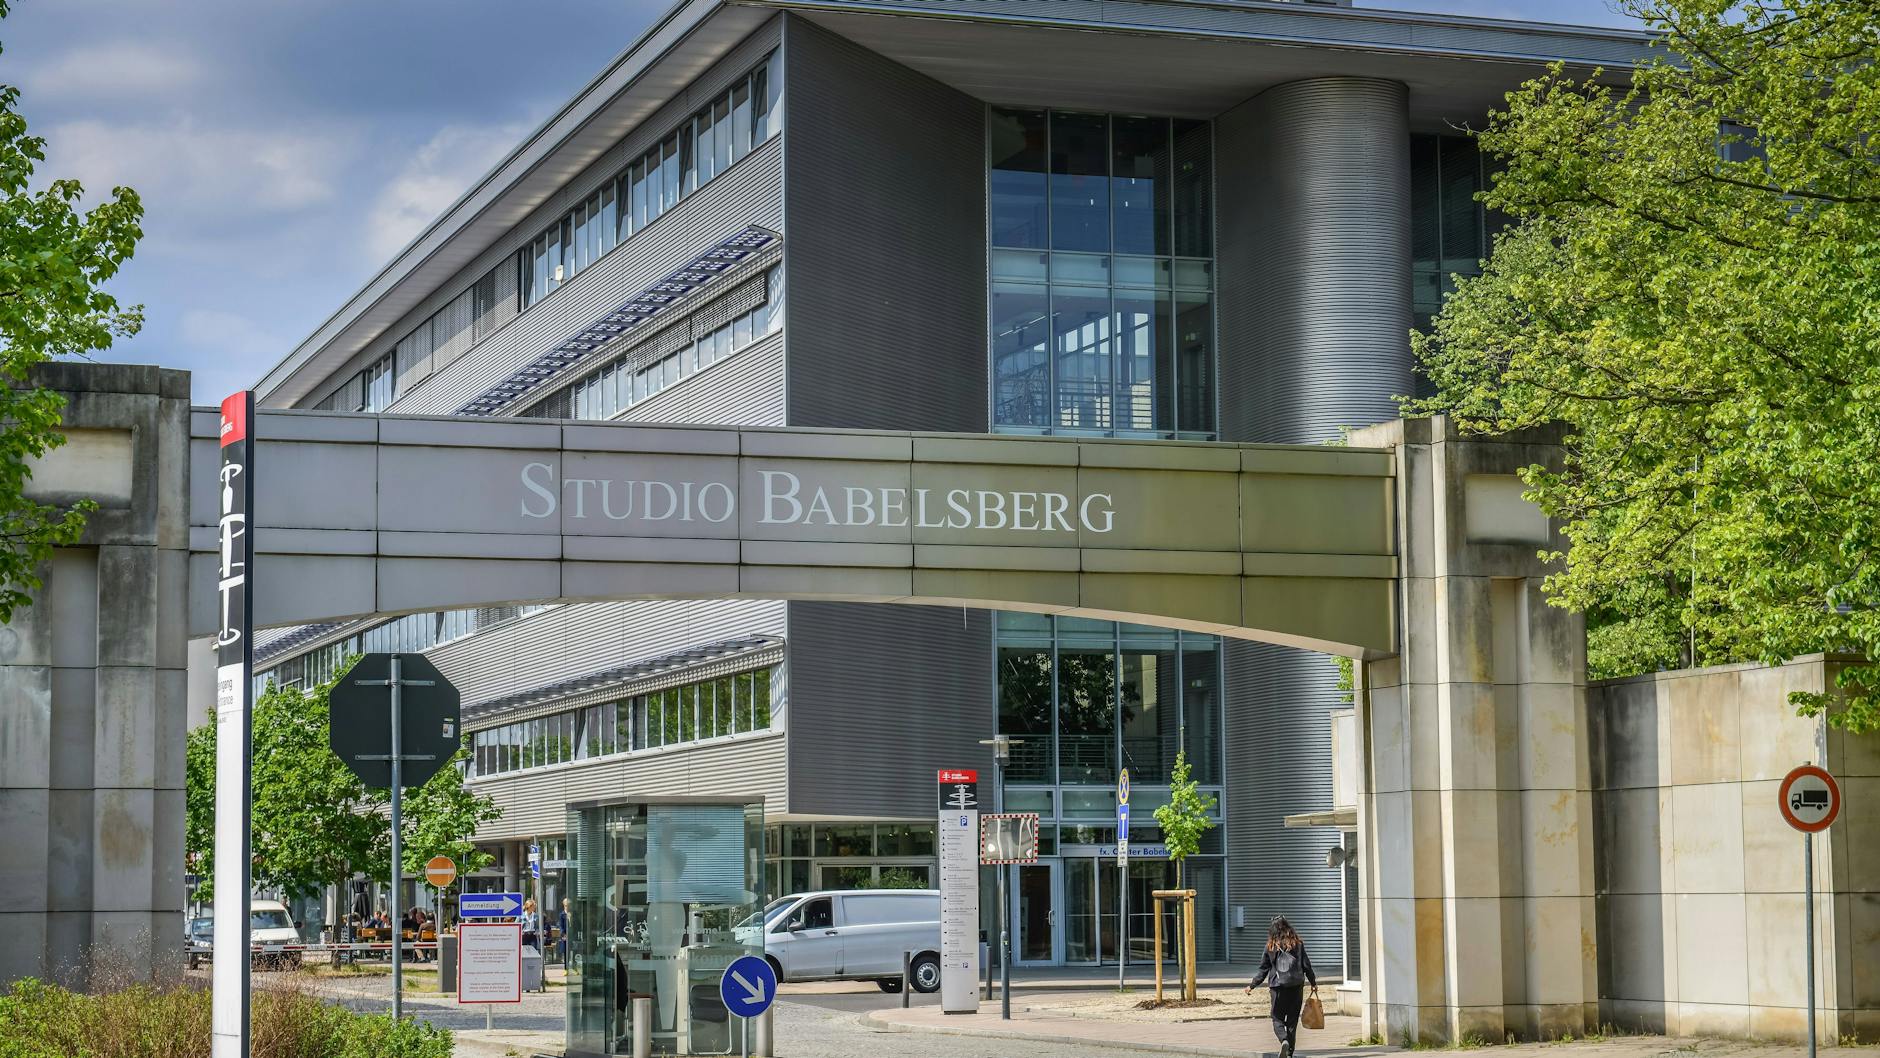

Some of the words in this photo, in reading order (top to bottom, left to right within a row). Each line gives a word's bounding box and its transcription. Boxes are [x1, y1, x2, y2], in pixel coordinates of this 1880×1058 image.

[520, 462, 735, 523] STUDIO
[757, 470, 1117, 533] BABELSBERG
[1112, 848, 1140, 856] Cter
